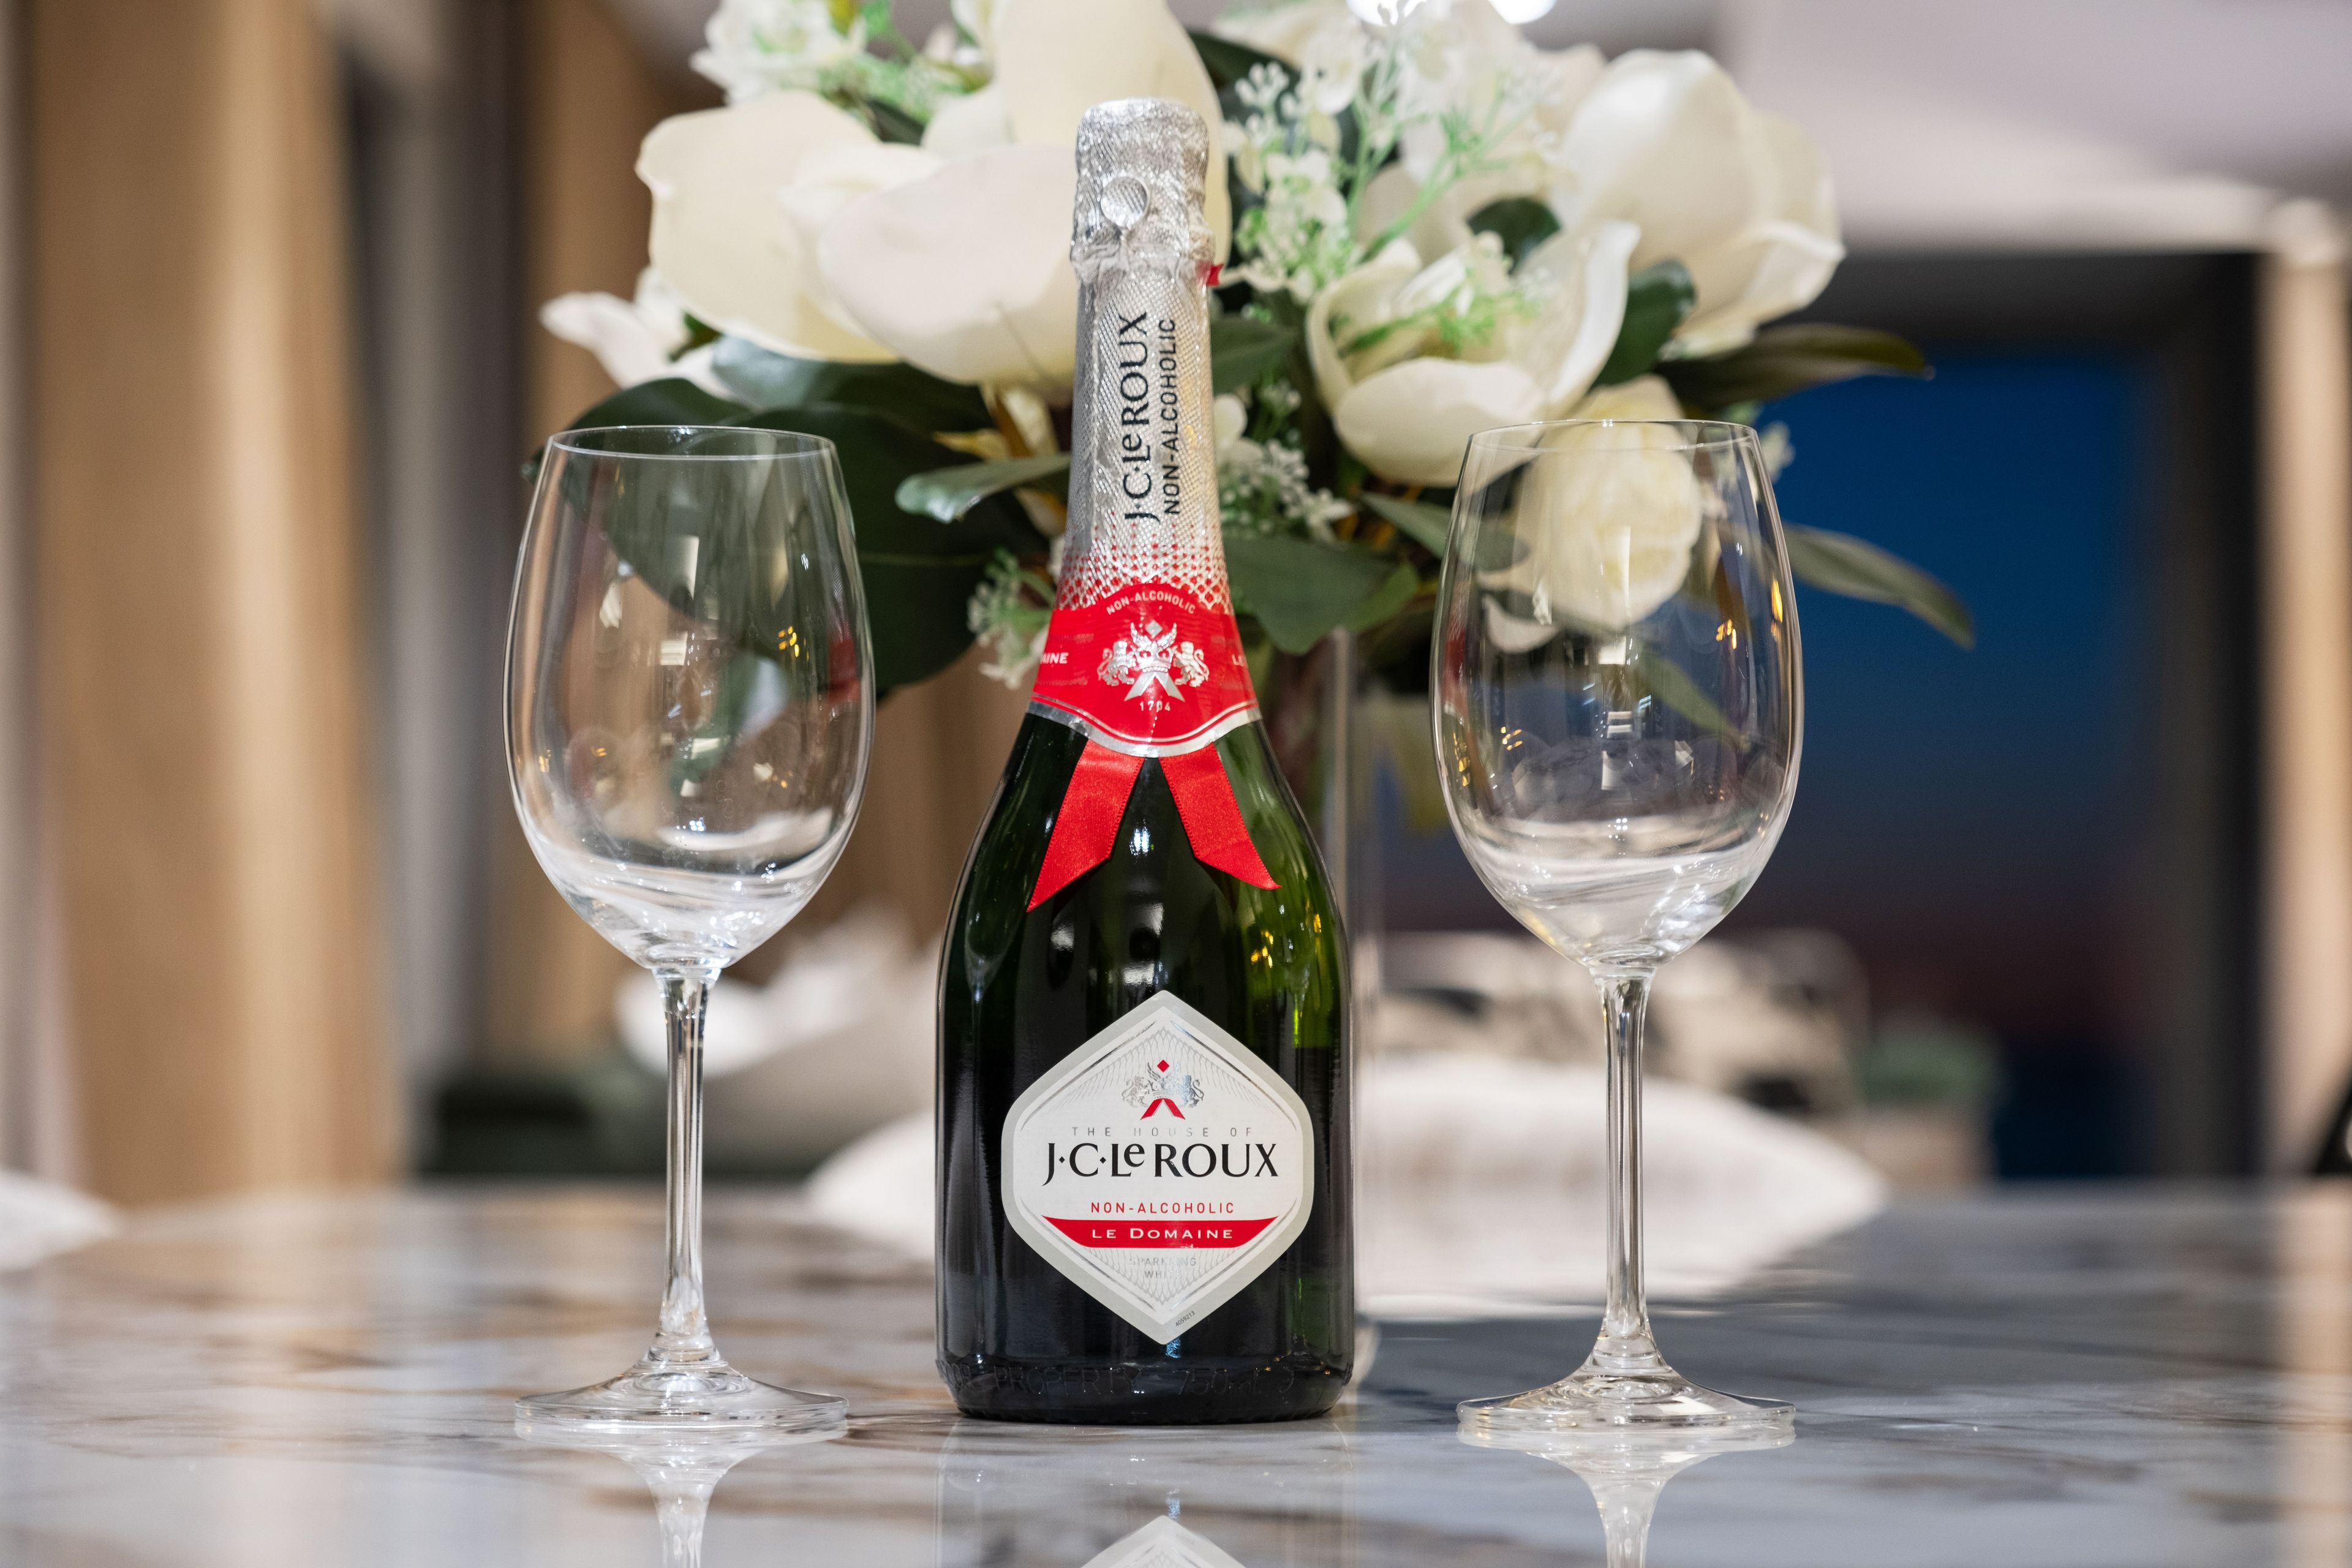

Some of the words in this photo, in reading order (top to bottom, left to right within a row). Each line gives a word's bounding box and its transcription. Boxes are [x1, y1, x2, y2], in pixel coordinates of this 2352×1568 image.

[1118, 312, 1150, 426] ROUX
[1159, 318, 1180, 515] NON-ALCOHOLIC
[1106, 590, 1196, 616] NON-ALCOHOLIC
[1139, 699, 1171, 712] 1704
[1071, 1126, 1112, 1137] THE
[1133, 1126, 1209, 1137] HOUSE
[1230, 1126, 1253, 1137] OF
[1153, 1142, 1279, 1178] ROUX
[1091, 1202, 1234, 1214] NON-ALCOHOLIC
[1091, 1229, 1117, 1239] LE
[1175, 1310, 1196, 1328] 4059213
